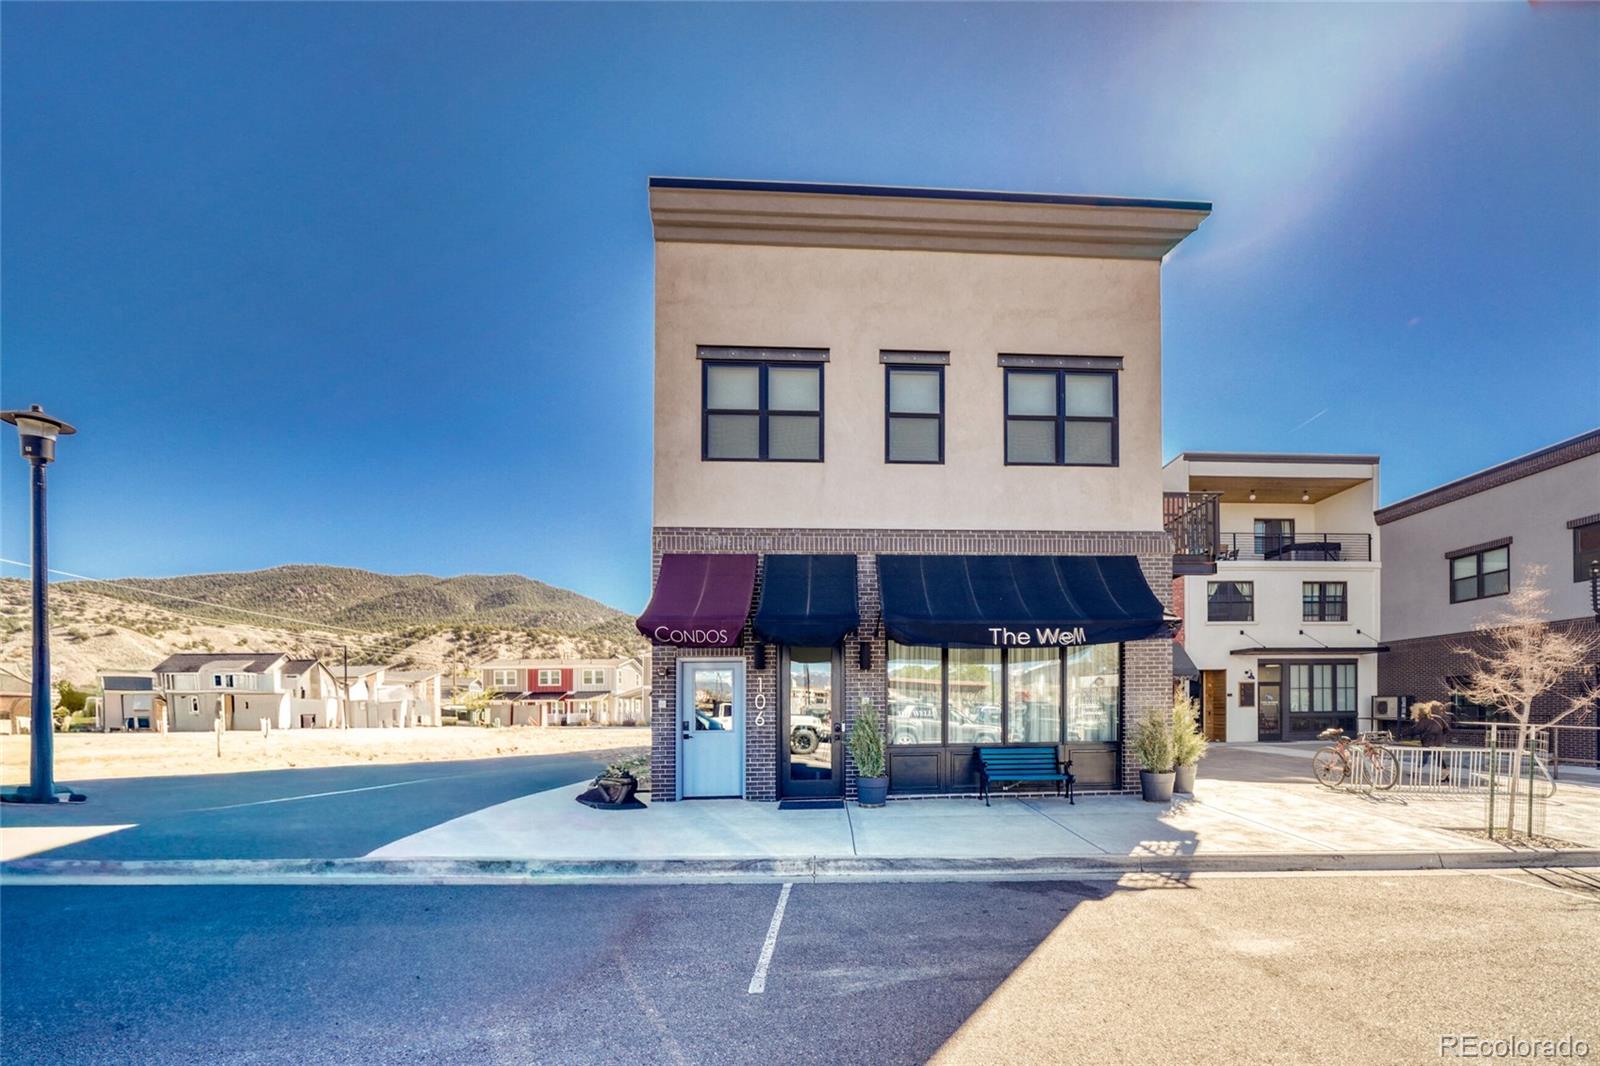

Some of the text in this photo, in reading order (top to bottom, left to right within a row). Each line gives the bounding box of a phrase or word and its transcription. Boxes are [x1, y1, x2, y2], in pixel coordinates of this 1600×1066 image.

[988, 627, 1087, 645] The Well
[755, 677, 766, 726] 106
